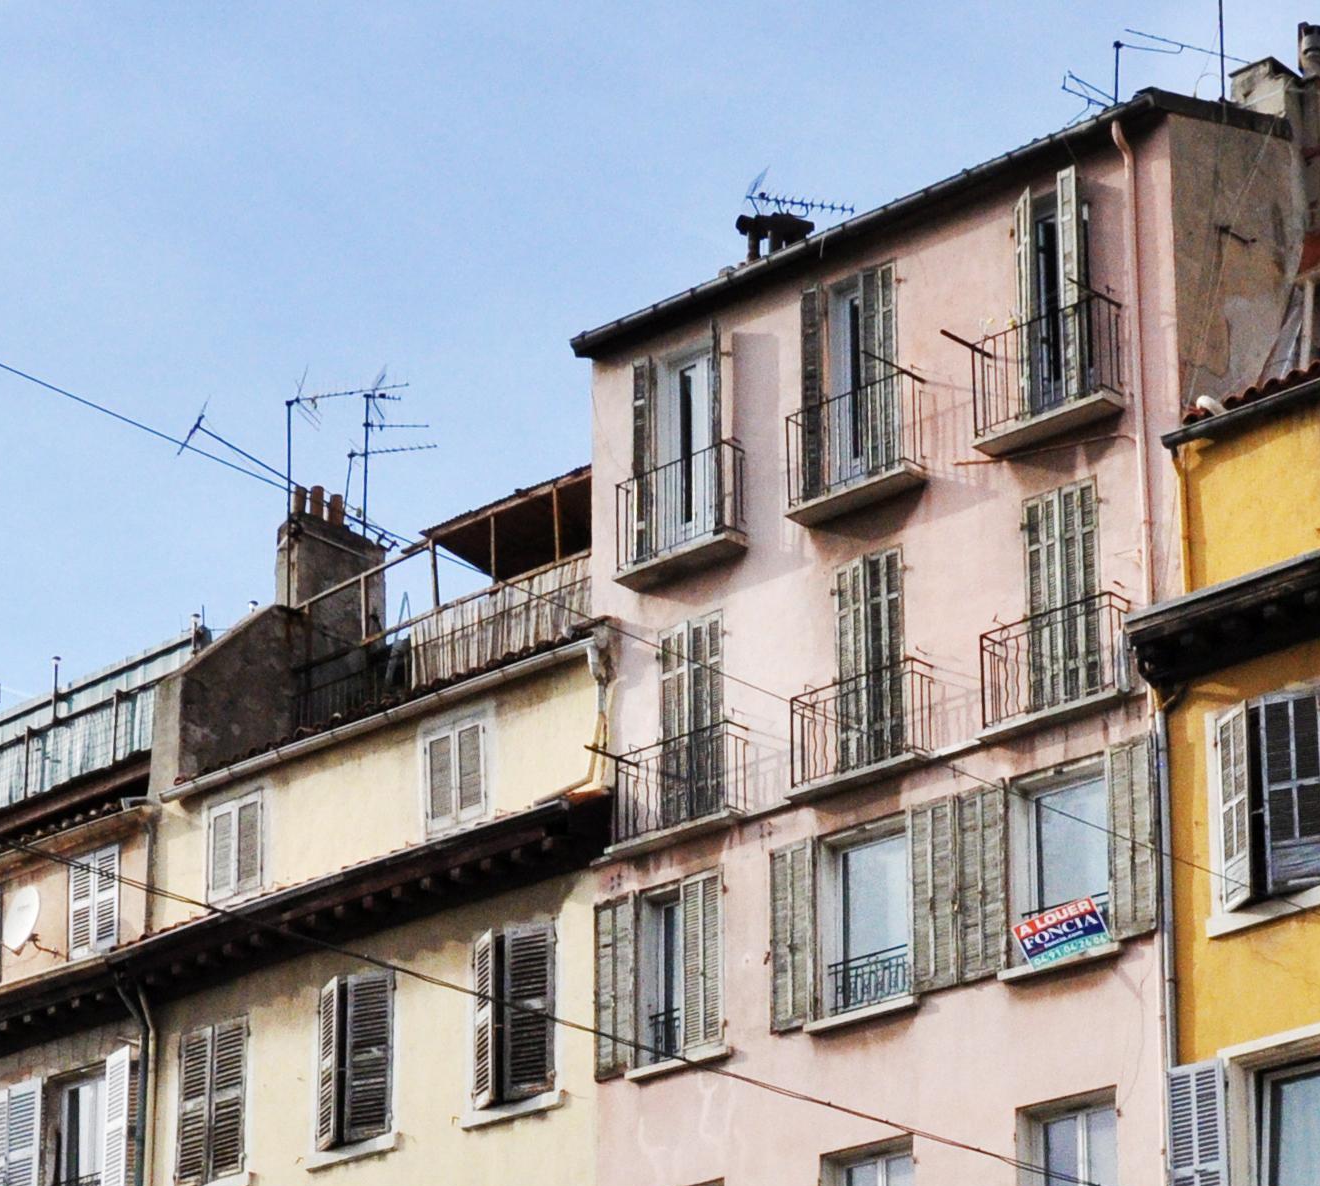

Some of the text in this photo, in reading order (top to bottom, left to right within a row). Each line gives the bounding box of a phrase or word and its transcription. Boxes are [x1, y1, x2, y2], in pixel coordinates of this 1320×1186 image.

[1019, 900, 1091, 938] A LOUER
[1022, 914, 1099, 950] FONCIA
